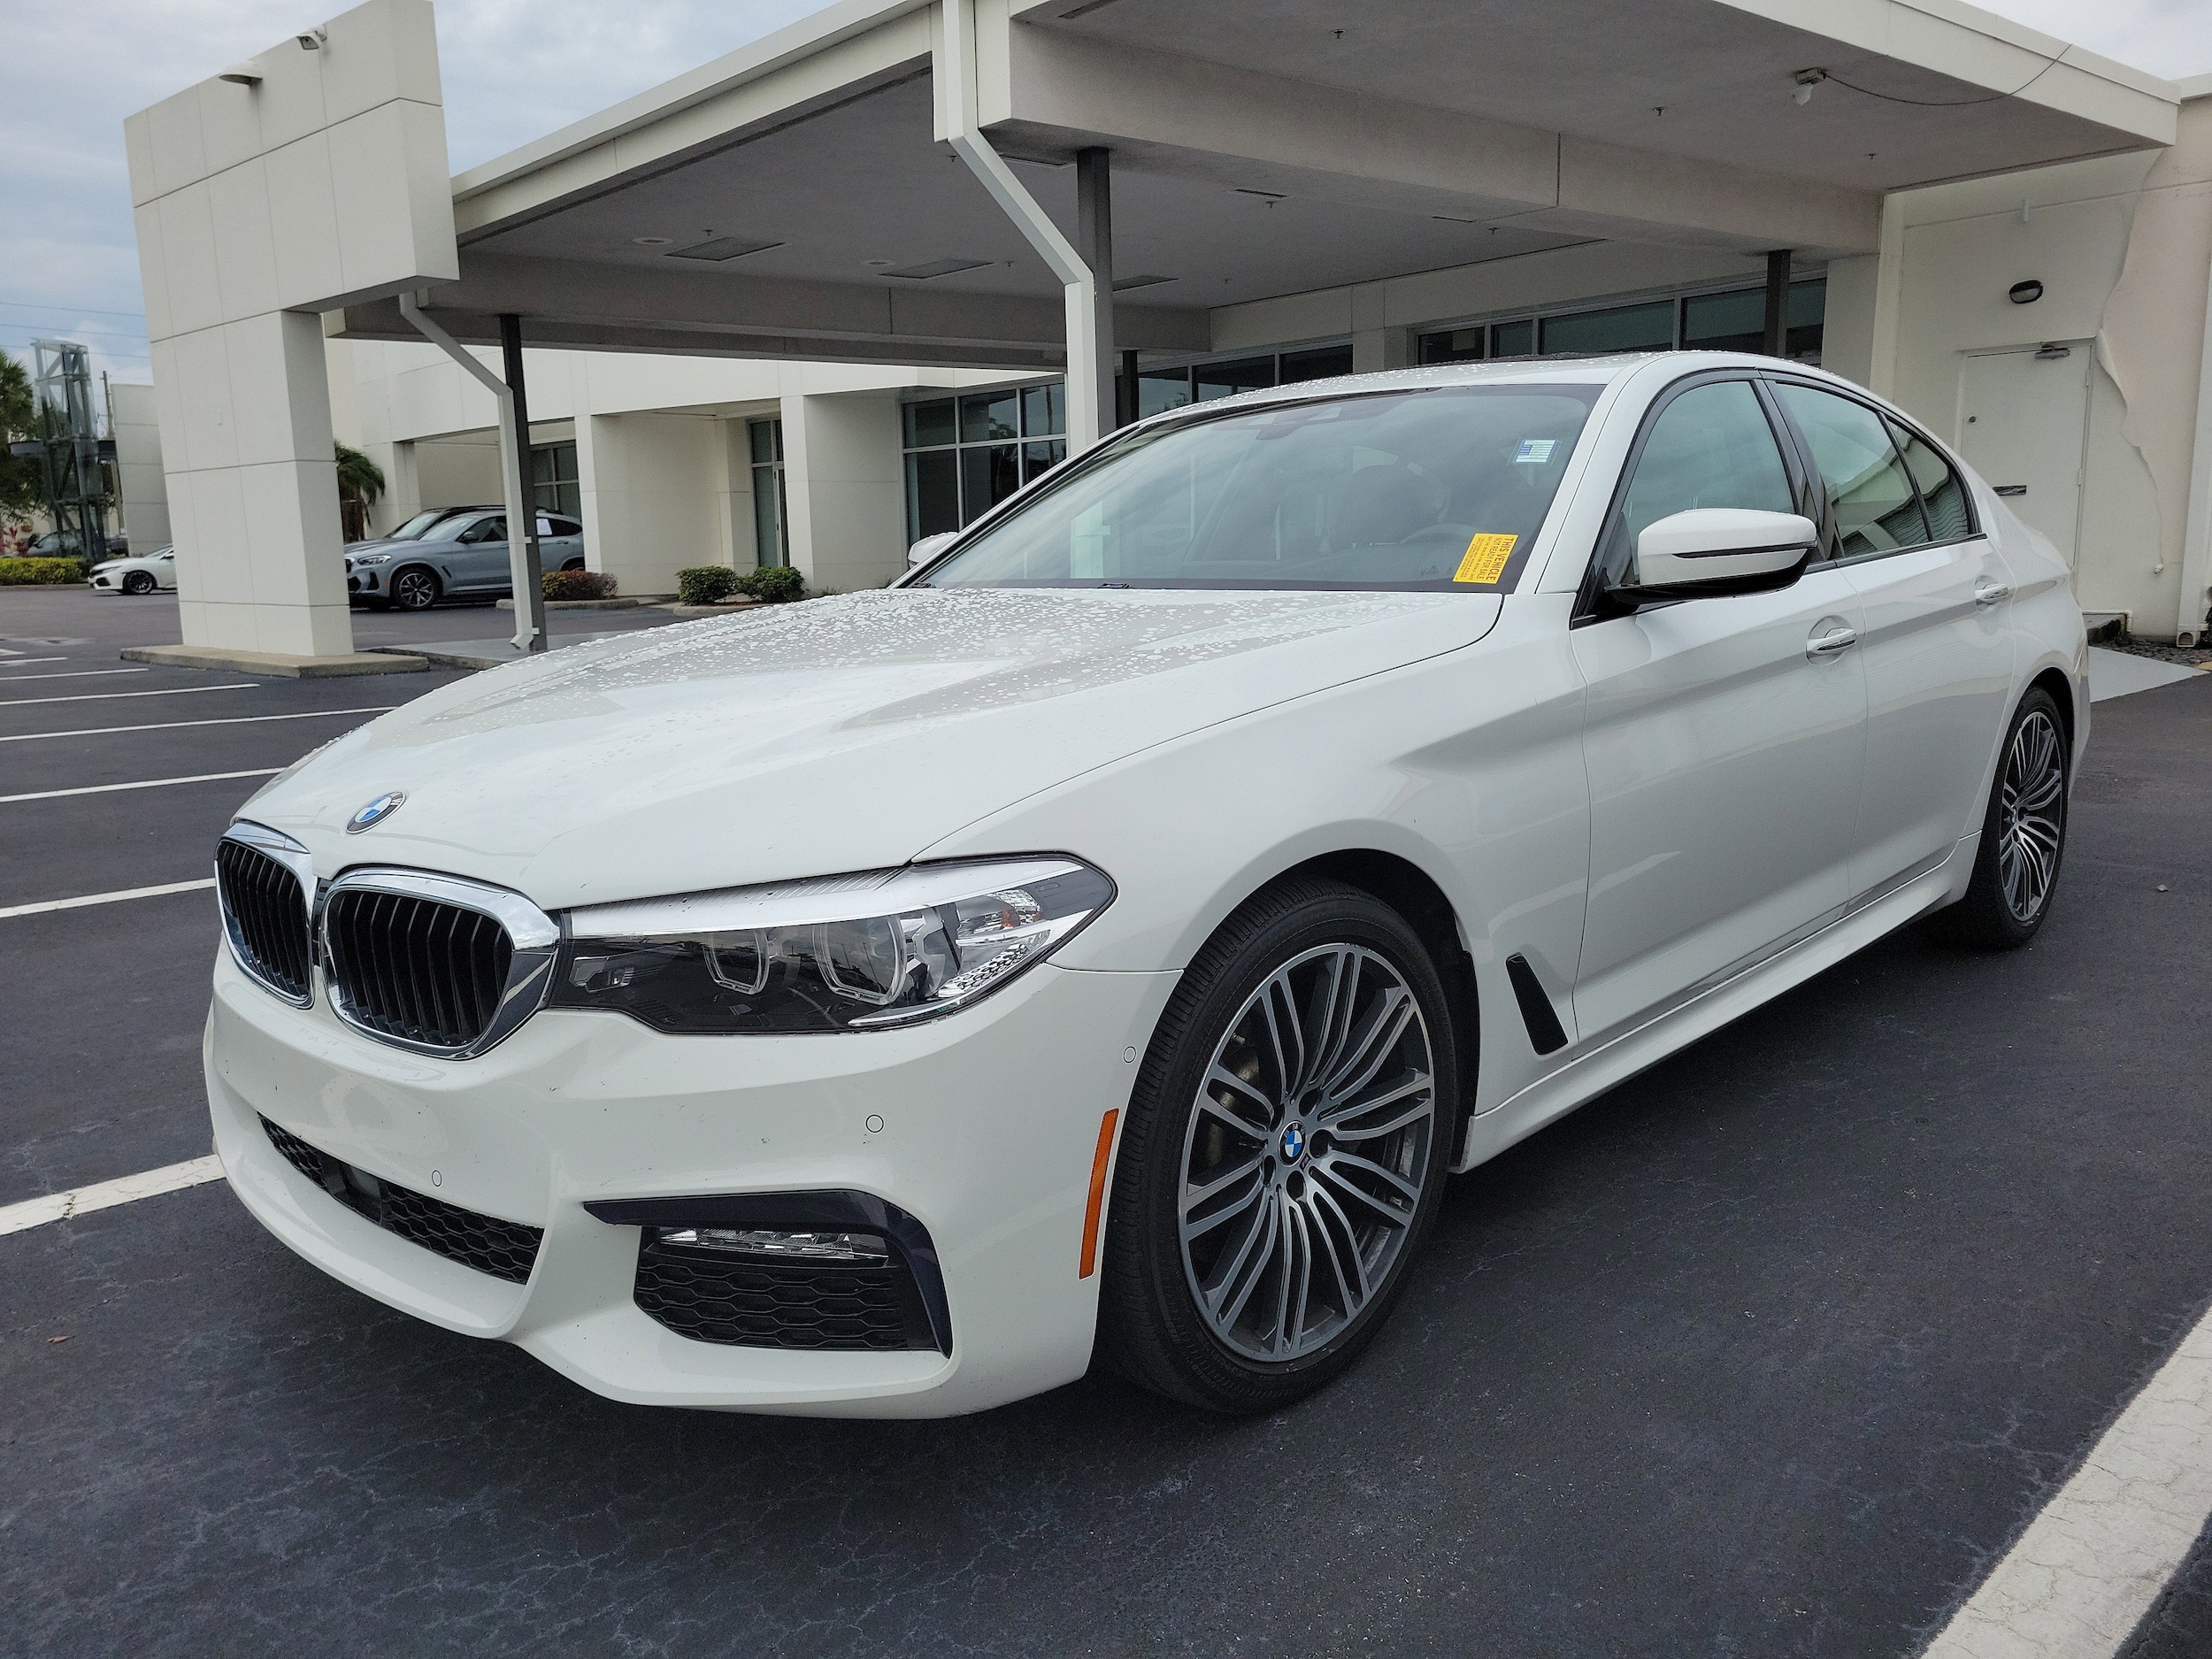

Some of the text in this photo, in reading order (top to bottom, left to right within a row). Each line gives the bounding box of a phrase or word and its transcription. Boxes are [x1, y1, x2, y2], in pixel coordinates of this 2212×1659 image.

[1486, 545, 1498, 559] READY
[1486, 537, 1514, 580] THIS VEHICLE
[1483, 559, 1492, 568] FOR
[1476, 568, 1487, 580] SALE
